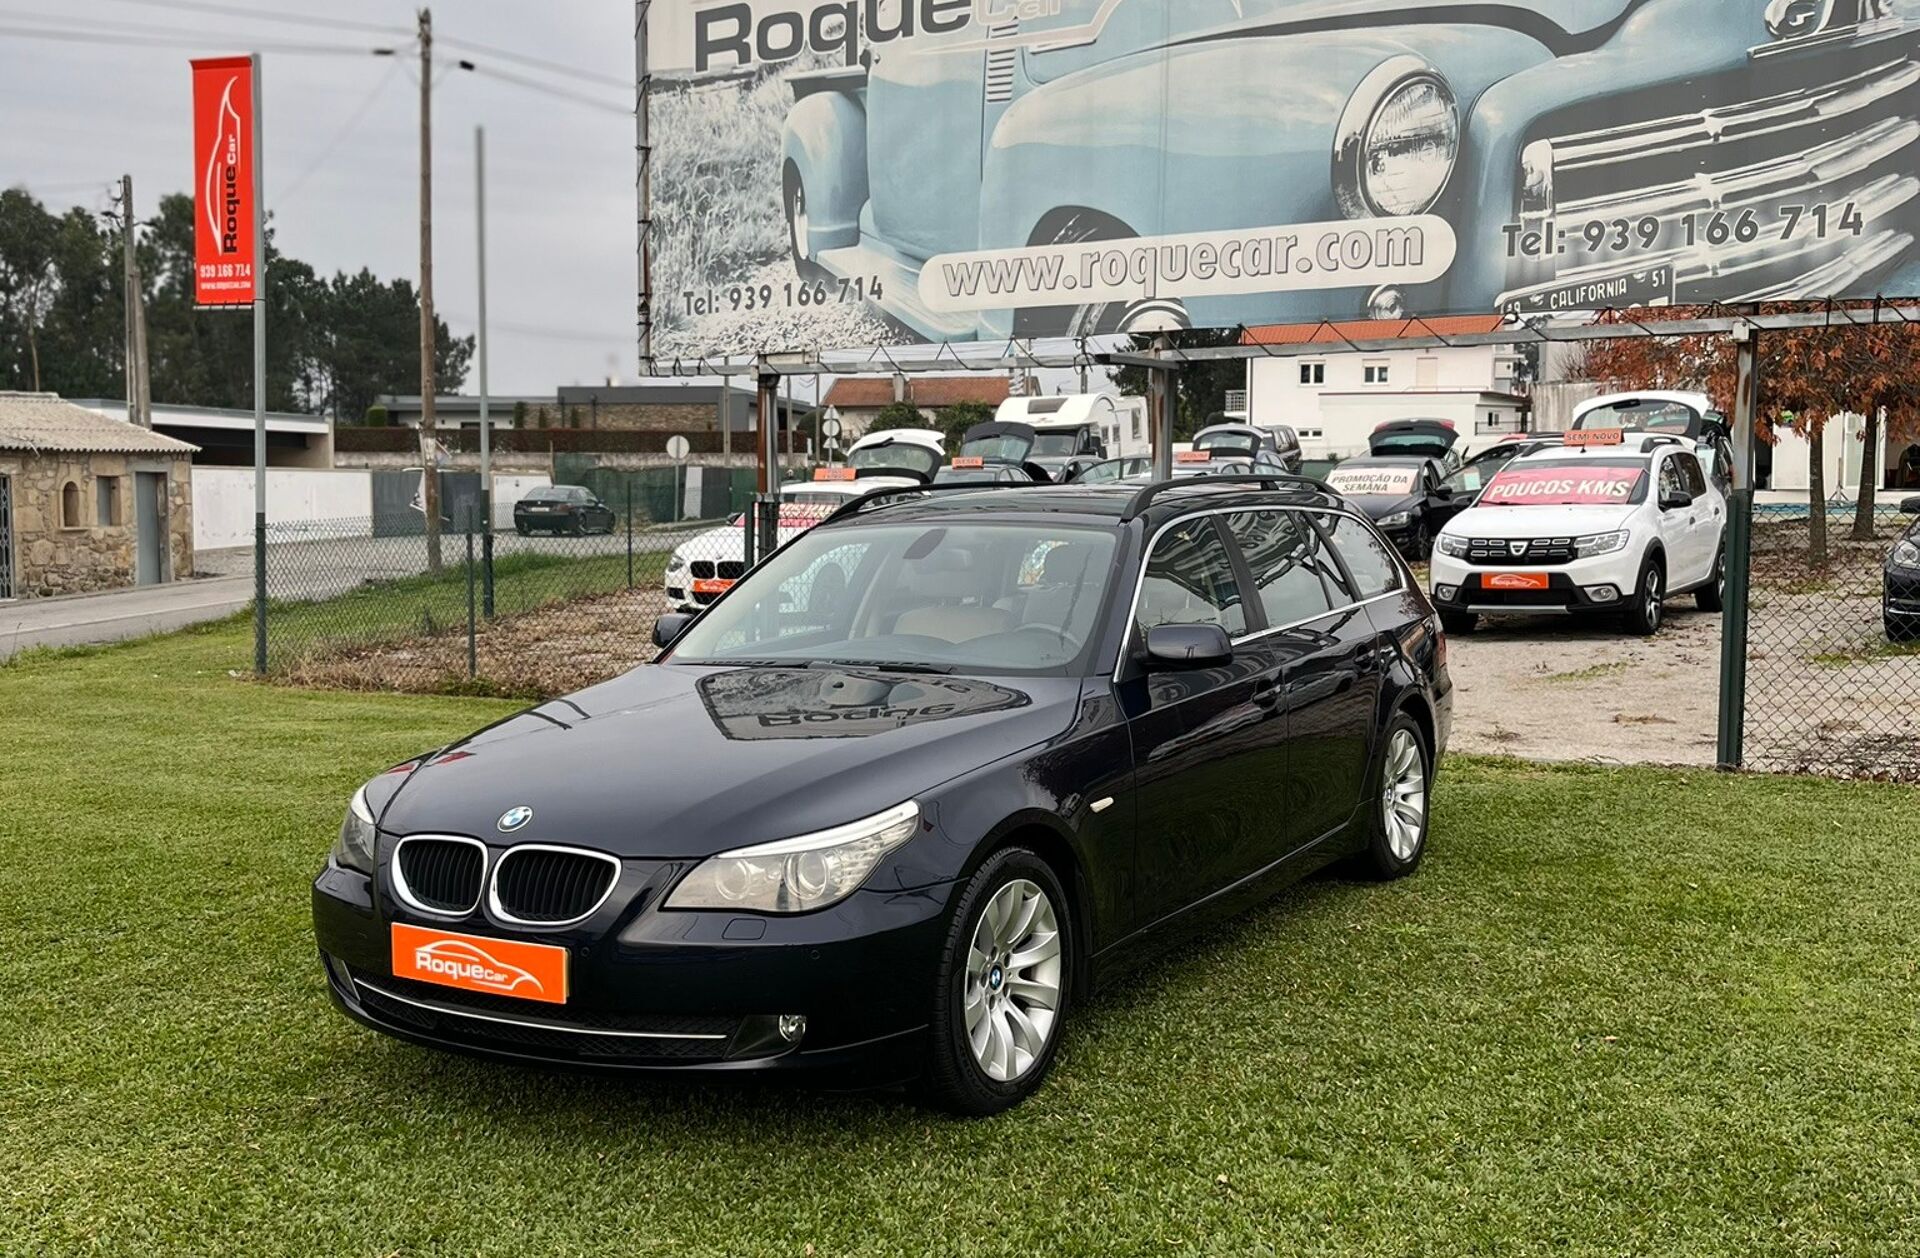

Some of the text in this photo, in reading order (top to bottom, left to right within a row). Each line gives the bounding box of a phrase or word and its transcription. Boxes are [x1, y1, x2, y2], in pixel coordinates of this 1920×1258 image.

[1502, 202, 1864, 257] Tel: 939 166 714
[200, 263, 251, 278] 939 166 714
[942, 225, 1425, 299] www.roquecar.com
[683, 275, 883, 316] Tel: 939 166 714
[1549, 277, 1628, 310] CALIFORNIA
[1652, 268, 1667, 287] 51
[1566, 432, 1620, 441] SEMI NOVO
[1342, 483, 1389, 492] SEMANA
[1393, 475, 1408, 484] DA
[1489, 480, 1631, 500] POUCOS KMS
